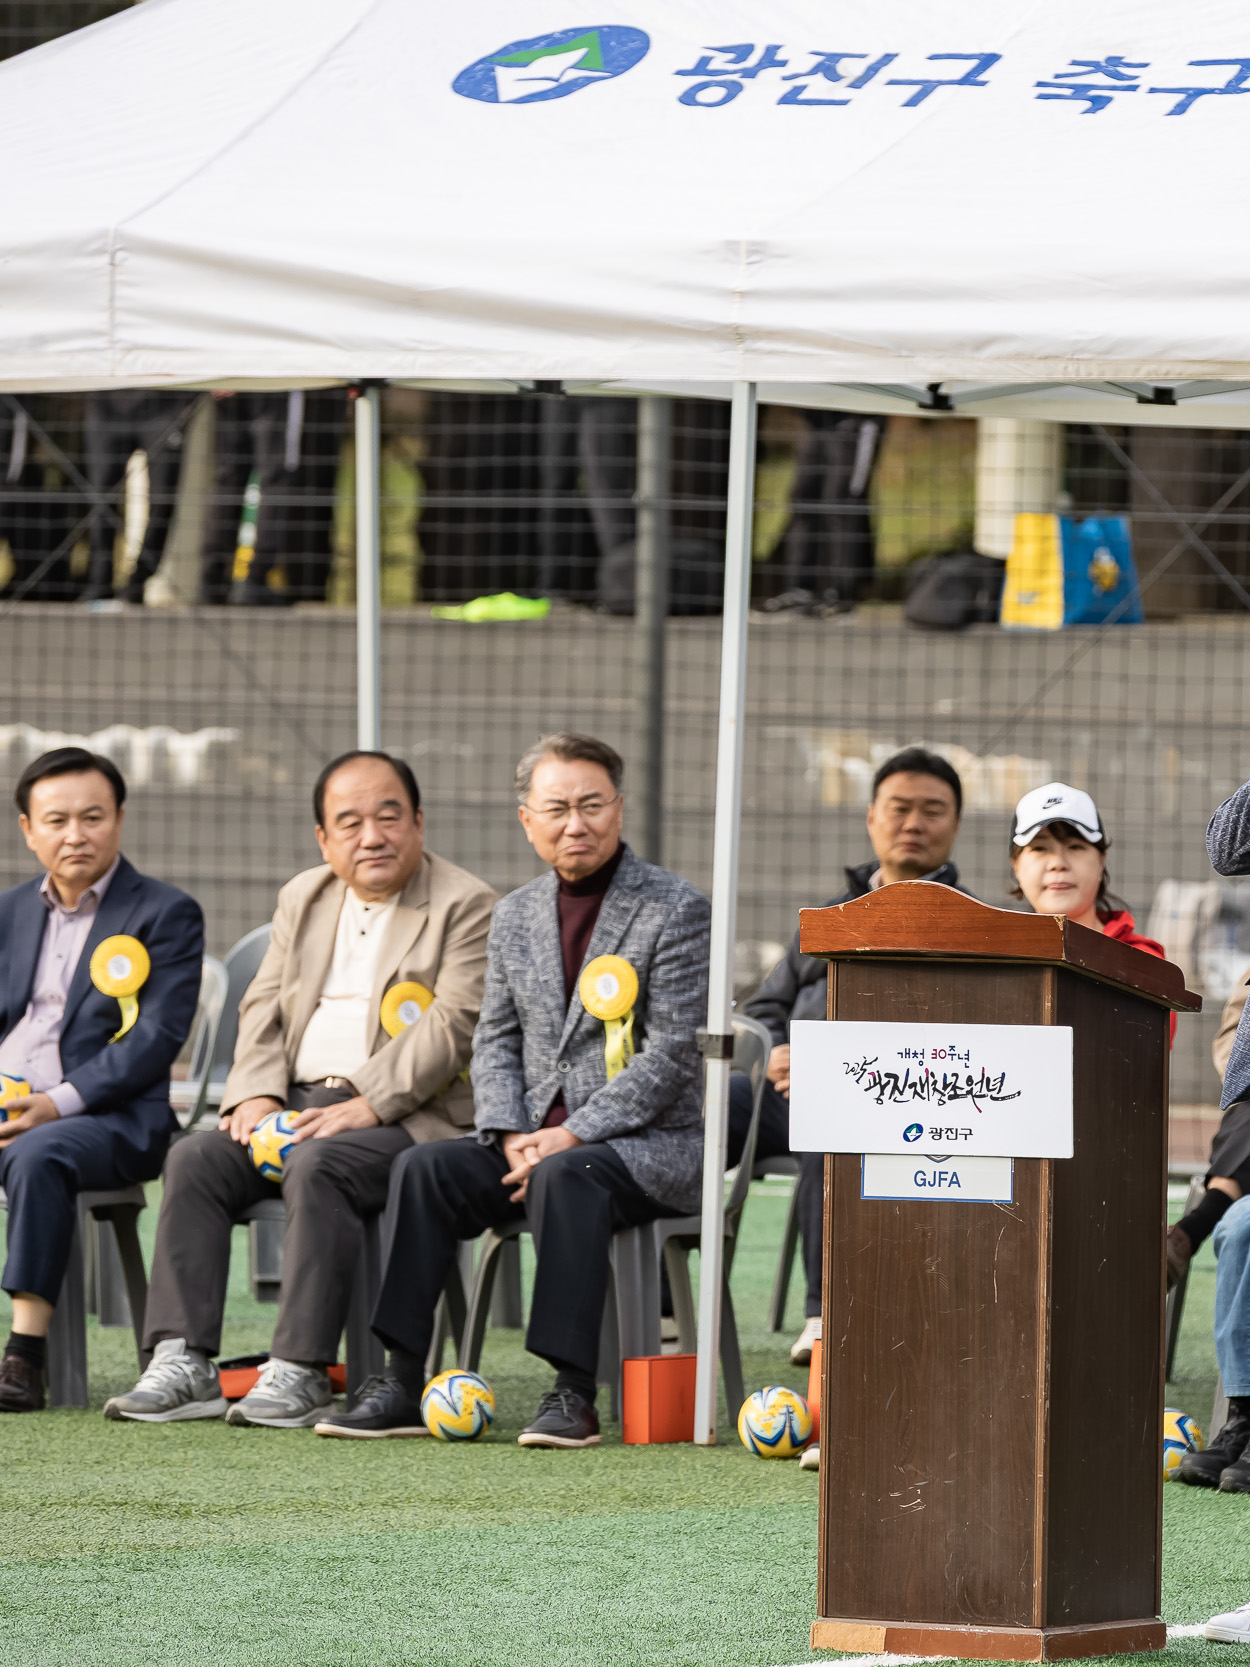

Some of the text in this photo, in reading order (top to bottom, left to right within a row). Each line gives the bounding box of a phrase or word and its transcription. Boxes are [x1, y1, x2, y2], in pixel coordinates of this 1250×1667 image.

[674, 43, 1003, 108] 광진구
[896, 1045, 970, 1068] 개청 30주년
[928, 1127, 974, 1141] 광진구
[913, 1170, 961, 1188] GJFA
